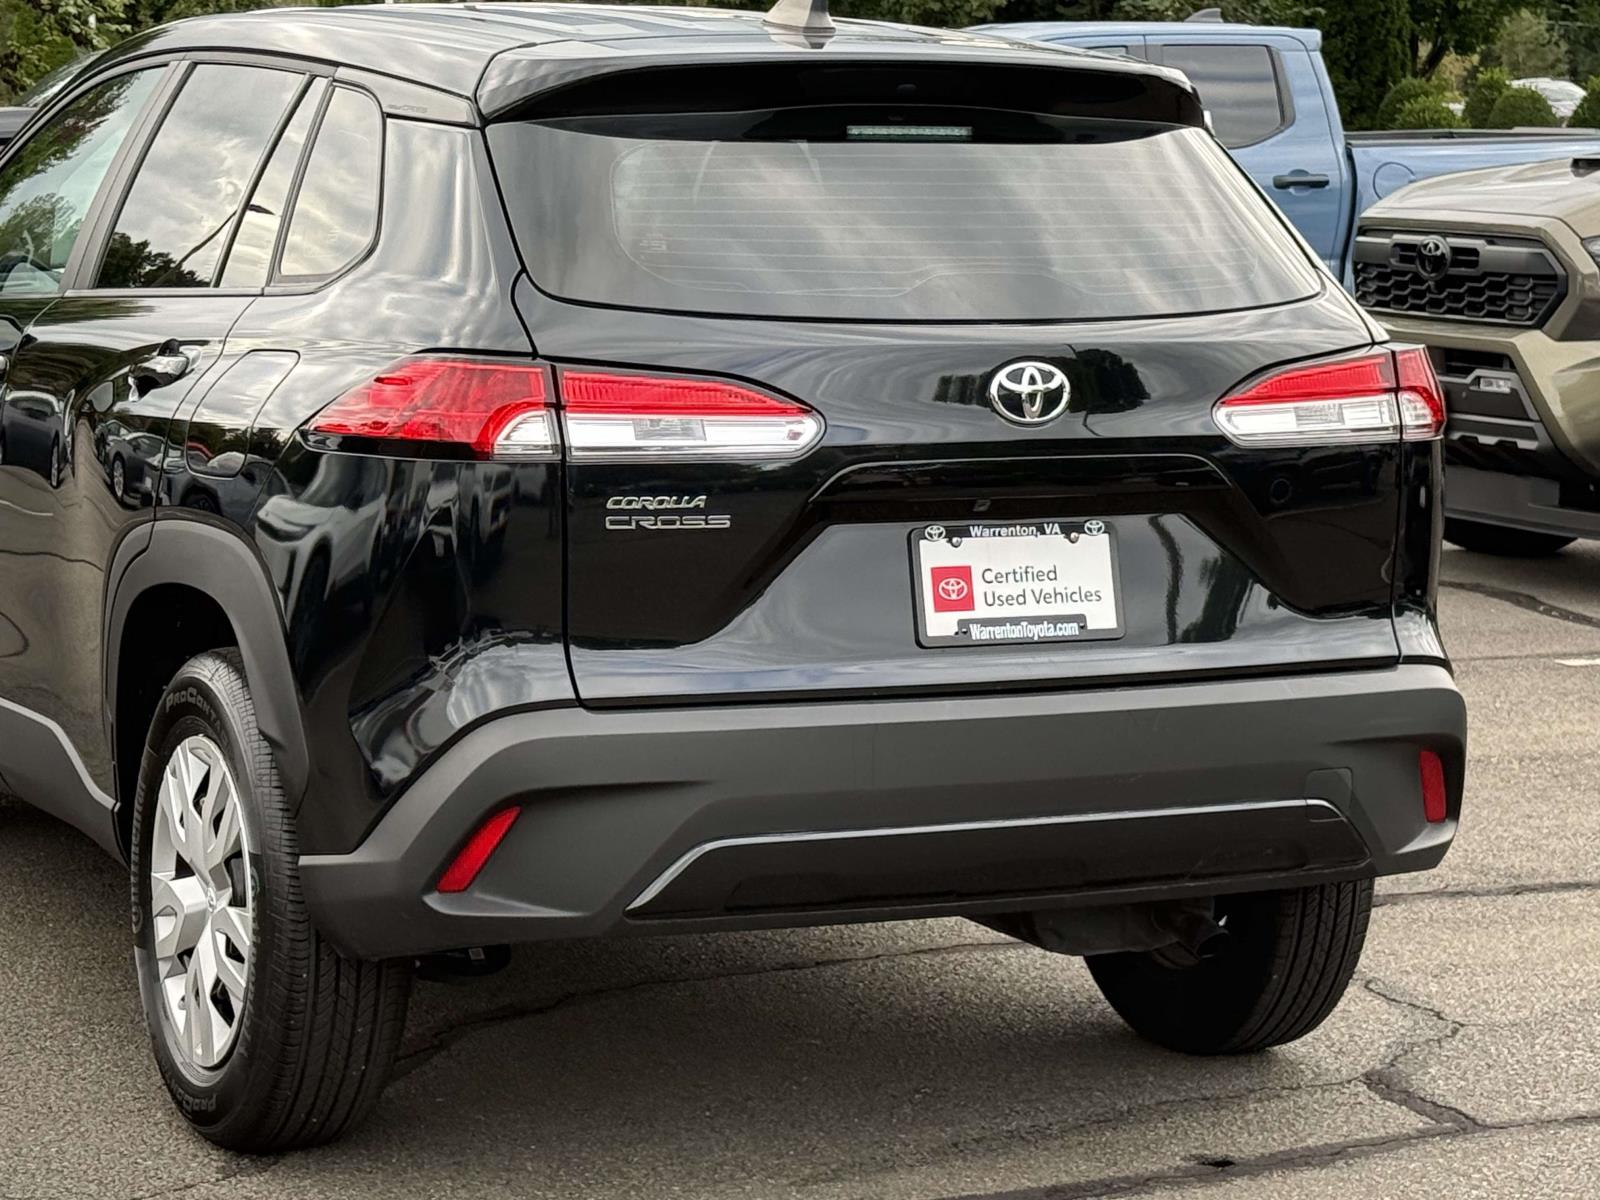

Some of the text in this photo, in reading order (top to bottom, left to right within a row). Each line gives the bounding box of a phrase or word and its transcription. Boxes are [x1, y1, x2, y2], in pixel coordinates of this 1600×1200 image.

[606, 495, 707, 510] COROLLA
[605, 515, 731, 530] CROSS
[969, 523, 1062, 538] Warrenton, VA
[981, 564, 1058, 584] Certified
[983, 585, 1102, 607] Used Vehicles
[969, 621, 1079, 641] WarrentonToyota.com
